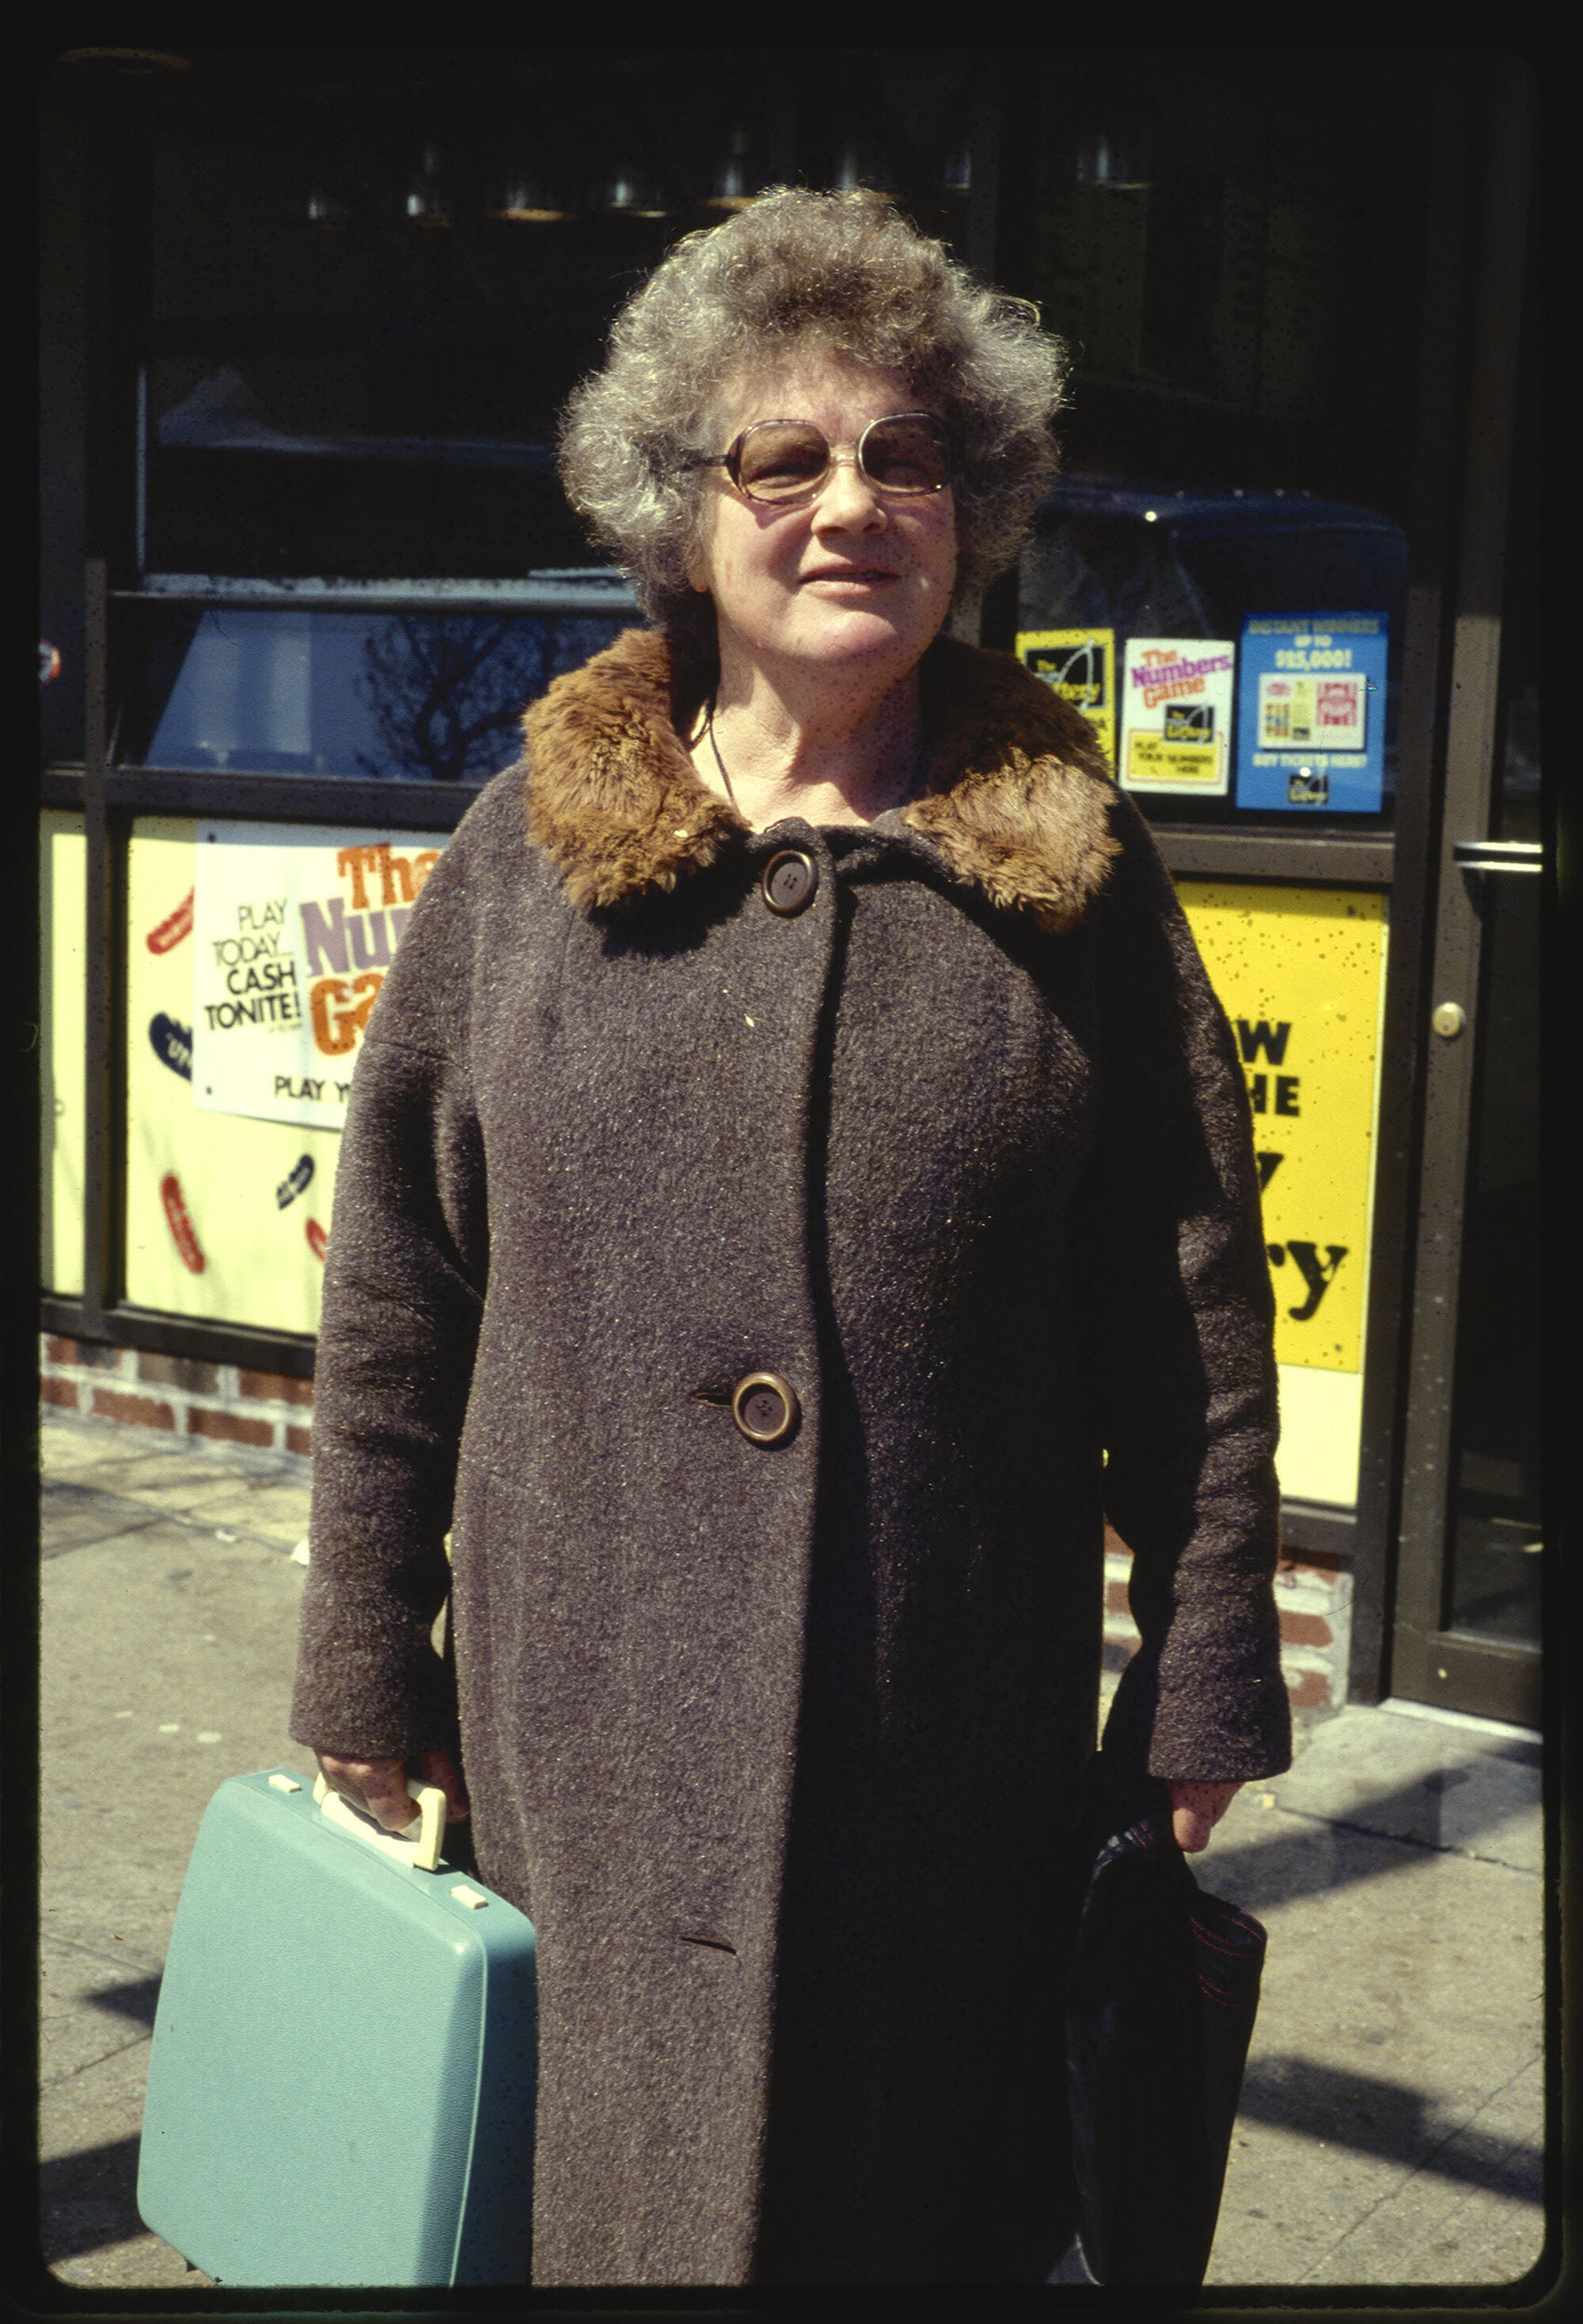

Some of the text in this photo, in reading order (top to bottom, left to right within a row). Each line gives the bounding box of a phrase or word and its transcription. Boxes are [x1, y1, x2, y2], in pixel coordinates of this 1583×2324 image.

[1132, 655, 1232, 688] Numbers
[1141, 648, 1177, 667] The
[1144, 677, 1204, 709] Game
[337, 842, 440, 909] The
[238, 898, 287, 932] PLAY
[227, 960, 296, 995] CASH
[203, 991, 302, 1031] TONITE!
[274, 1075, 325, 1101] PLAY
